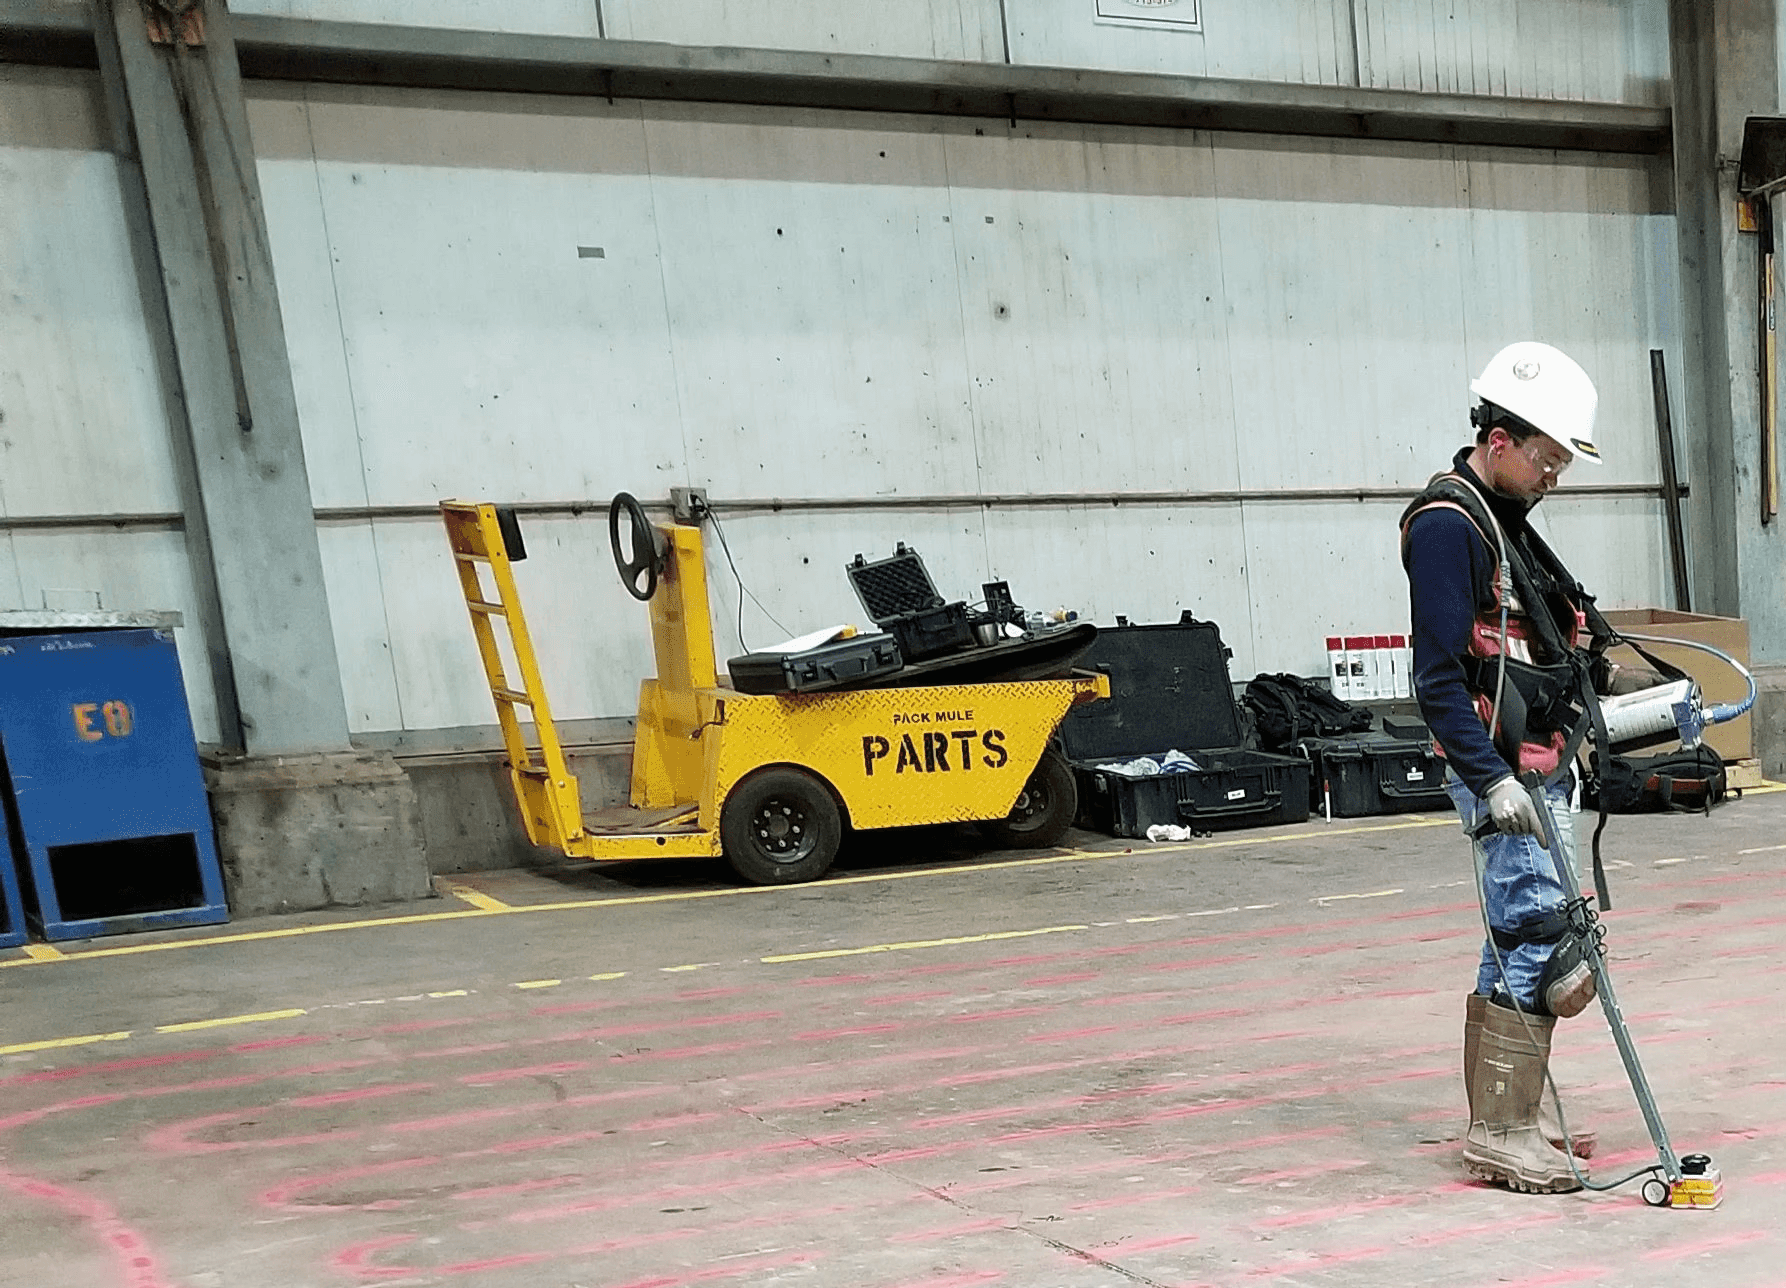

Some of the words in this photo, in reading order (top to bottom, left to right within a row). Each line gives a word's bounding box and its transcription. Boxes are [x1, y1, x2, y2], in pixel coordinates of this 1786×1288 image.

[893, 712, 930, 725] PACK
[935, 710, 974, 722] MULE
[862, 729, 1008, 777] PARTS
